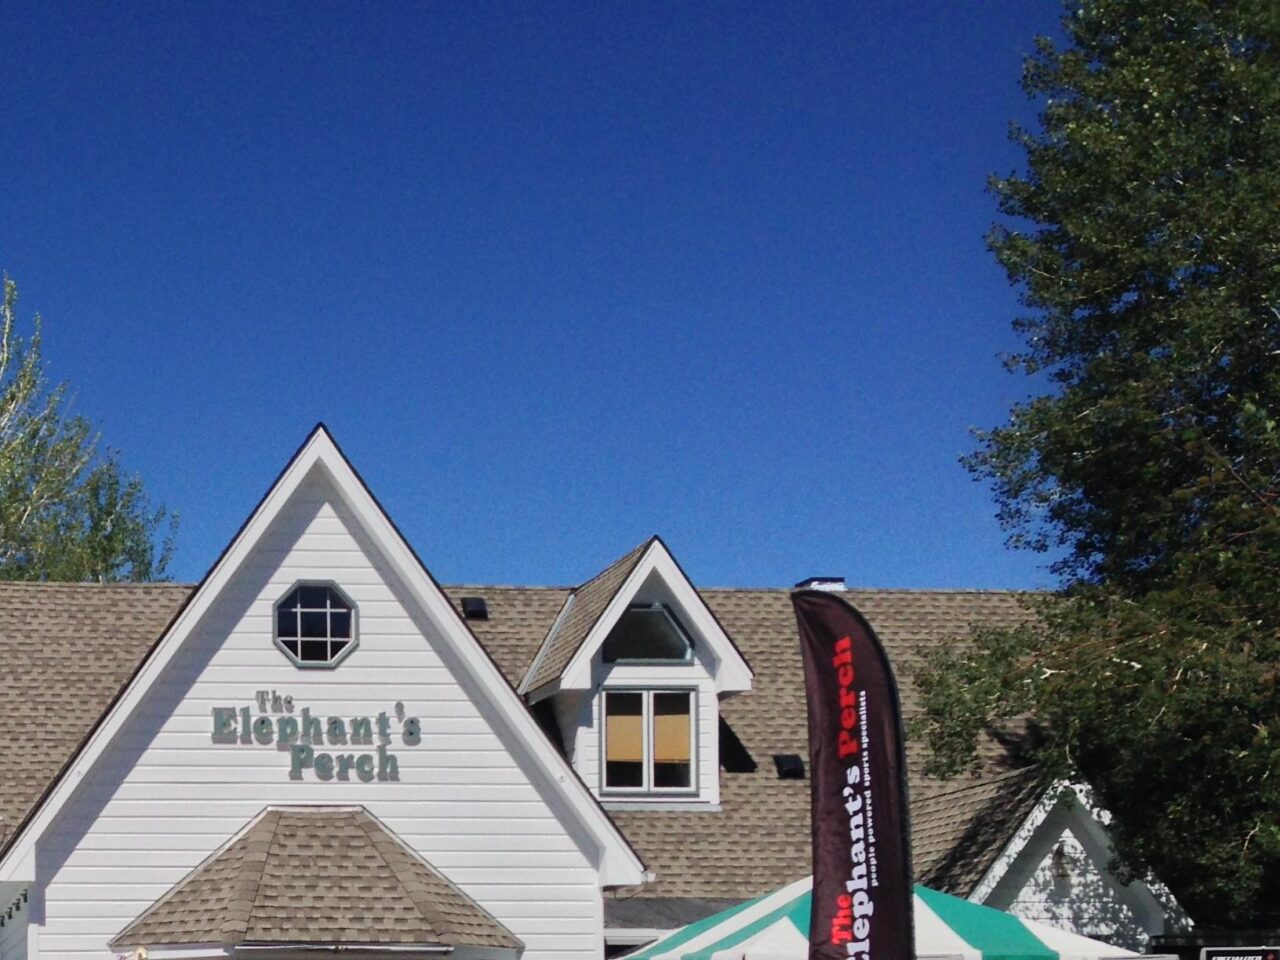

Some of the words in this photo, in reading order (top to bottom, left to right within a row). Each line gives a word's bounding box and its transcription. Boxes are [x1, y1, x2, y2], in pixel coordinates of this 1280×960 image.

[255, 690, 295, 713] The
[833, 636, 858, 758] Perch
[211, 700, 422, 752] Elephant's
[288, 744, 401, 783] Perch
[862, 751, 871, 786] sports
[864, 790, 876, 844] powered
[868, 846, 879, 887] people
[831, 894, 852, 945] The
